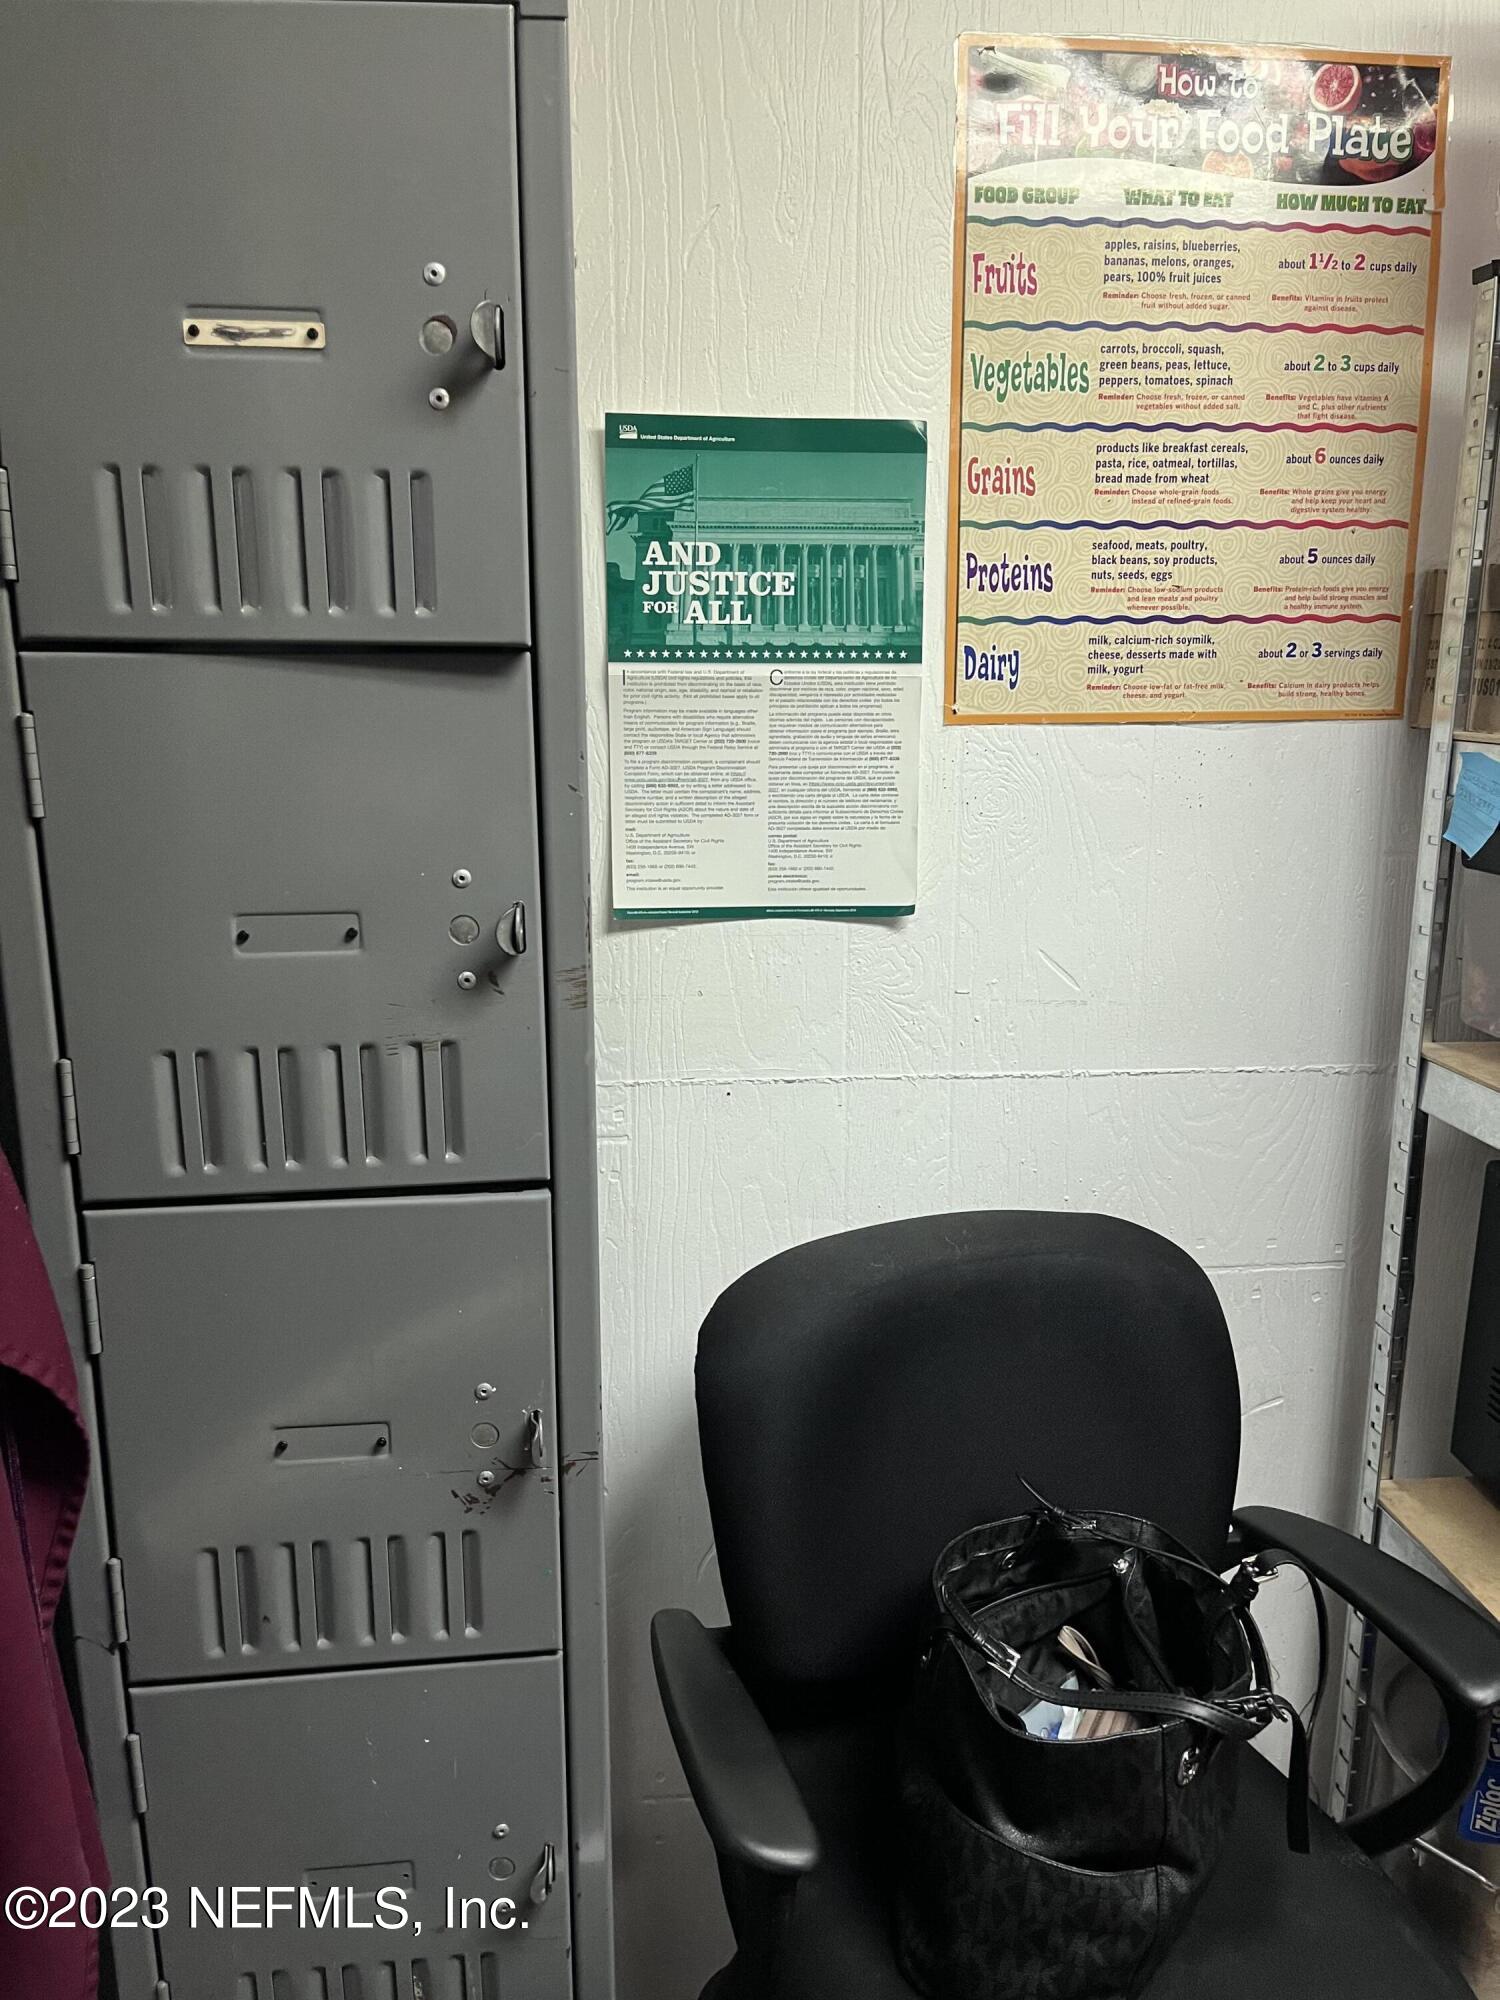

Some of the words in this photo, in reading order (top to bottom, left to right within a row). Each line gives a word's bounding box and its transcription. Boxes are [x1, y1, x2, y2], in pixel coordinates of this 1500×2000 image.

[1157, 63, 1218, 97] How
[1230, 69, 1260, 98] to
[996, 101, 1063, 149] Fill
[1082, 102, 1185, 149] Your
[1199, 109, 1290, 154] Food
[1307, 111, 1414, 161] Plate
[974, 185, 1018, 203] FOOD
[1022, 187, 1080, 205] GROUP
[1124, 187, 1174, 207] WHAT
[1177, 190, 1199, 208] TO
[1204, 191, 1235, 208] EAT
[1276, 193, 1317, 211] HOW
[1321, 194, 1369, 213] MUCH
[1372, 196, 1392, 214] TO
[1396, 197, 1428, 216] EAT
[1105, 239, 1140, 251] apples,
[1144, 240, 1179, 251] raisins,
[1183, 240, 1240, 253] blueberries,
[1104, 256, 1148, 266] bananas,
[1152, 256, 1189, 267] melons,
[1193, 258, 1234, 270] oranges,
[1279, 259, 1305, 269] about
[1341, 261, 1350, 270] to
[1354, 254, 1365, 270] 2
[1370, 263, 1391, 274] cups
[1395, 262, 1417, 274] daily
[973, 252, 1037, 295] Fruits
[1104, 273, 1134, 284] pears,
[1138, 272, 1165, 282] 100%
[1169, 272, 1189, 283] fruit
[1193, 273, 1221, 285] juices
[1101, 344, 1138, 354] carrots,
[1142, 343, 1184, 355] broccoli,
[1188, 344, 1224, 356] squash,
[1099, 361, 1127, 371] green
[1131, 359, 1162, 370] beans,
[1166, 361, 1190, 371] peas,
[1194, 360, 1230, 371] lettuce,
[1284, 361, 1310, 371] about
[1314, 355, 1325, 371] 2
[1328, 362, 1336, 371] to
[1340, 355, 1351, 371] 3
[1354, 364, 1375, 374] cups
[1378, 362, 1399, 374] daily
[970, 351, 1089, 403] Vegetables
[1099, 376, 1141, 387] peppers,
[1145, 376, 1192, 386] tomatoes,
[1196, 376, 1233, 387] spinach
[1096, 443, 1139, 454] products
[1143, 443, 1159, 453] like
[1163, 443, 1208, 453] breakfast
[1211, 443, 1248, 454] cereals,
[1286, 455, 1311, 464] about
[1315, 448, 1326, 464] 6
[1330, 456, 1360, 464] ounces
[1363, 454, 1384, 465] daily
[1096, 460, 1124, 470] pasta,
[1128, 459, 1149, 469] rice,
[1153, 459, 1193, 469] oatmeal,
[1197, 458, 1237, 469] tortillas,
[967, 457, 1036, 496] Grains
[1095, 473, 1122, 483] bread
[1126, 473, 1151, 483] made
[1155, 473, 1177, 483] from
[1181, 474, 1209, 483] wheat
[642, 541, 721, 565] AND
[1093, 540, 1132, 551] seafood,
[1136, 541, 1167, 551] meats,
[1092, 555, 1116, 565] black
[1120, 555, 1150, 566] beans,
[1154, 558, 1169, 566] soy
[1173, 555, 1217, 566] products,
[1280, 555, 1304, 564] about
[1307, 548, 1318, 564] 5
[1322, 556, 1352, 564] ounces
[1355, 554, 1375, 565] daily
[967, 552, 1053, 592] Proteins
[1091, 570, 1114, 580] nuts,
[1118, 570, 1147, 580] seeds,
[1151, 572, 1172, 581] eggs
[642, 571, 794, 596] JUSTICE
[643, 602, 678, 613] FOR
[684, 601, 752, 624] ALL
[1089, 636, 1111, 646] milk,
[1115, 635, 1173, 645] calcium-rich
[1176, 635, 1215, 646] soymilk,
[1088, 650, 1123, 660] cheese,
[1127, 650, 1166, 659] desserts
[1169, 650, 1194, 659] made
[1198, 649, 1217, 659] with
[1259, 649, 1283, 658] about
[1286, 642, 1296, 657] 2
[1312, 642, 1322, 657] 3
[1324, 649, 1360, 659] servings
[1363, 648, 1382, 659] daily
[964, 645, 1019, 690] Dairy
[1088, 665, 1110, 675] milk,
[1113, 665, 1143, 676] yogurt
